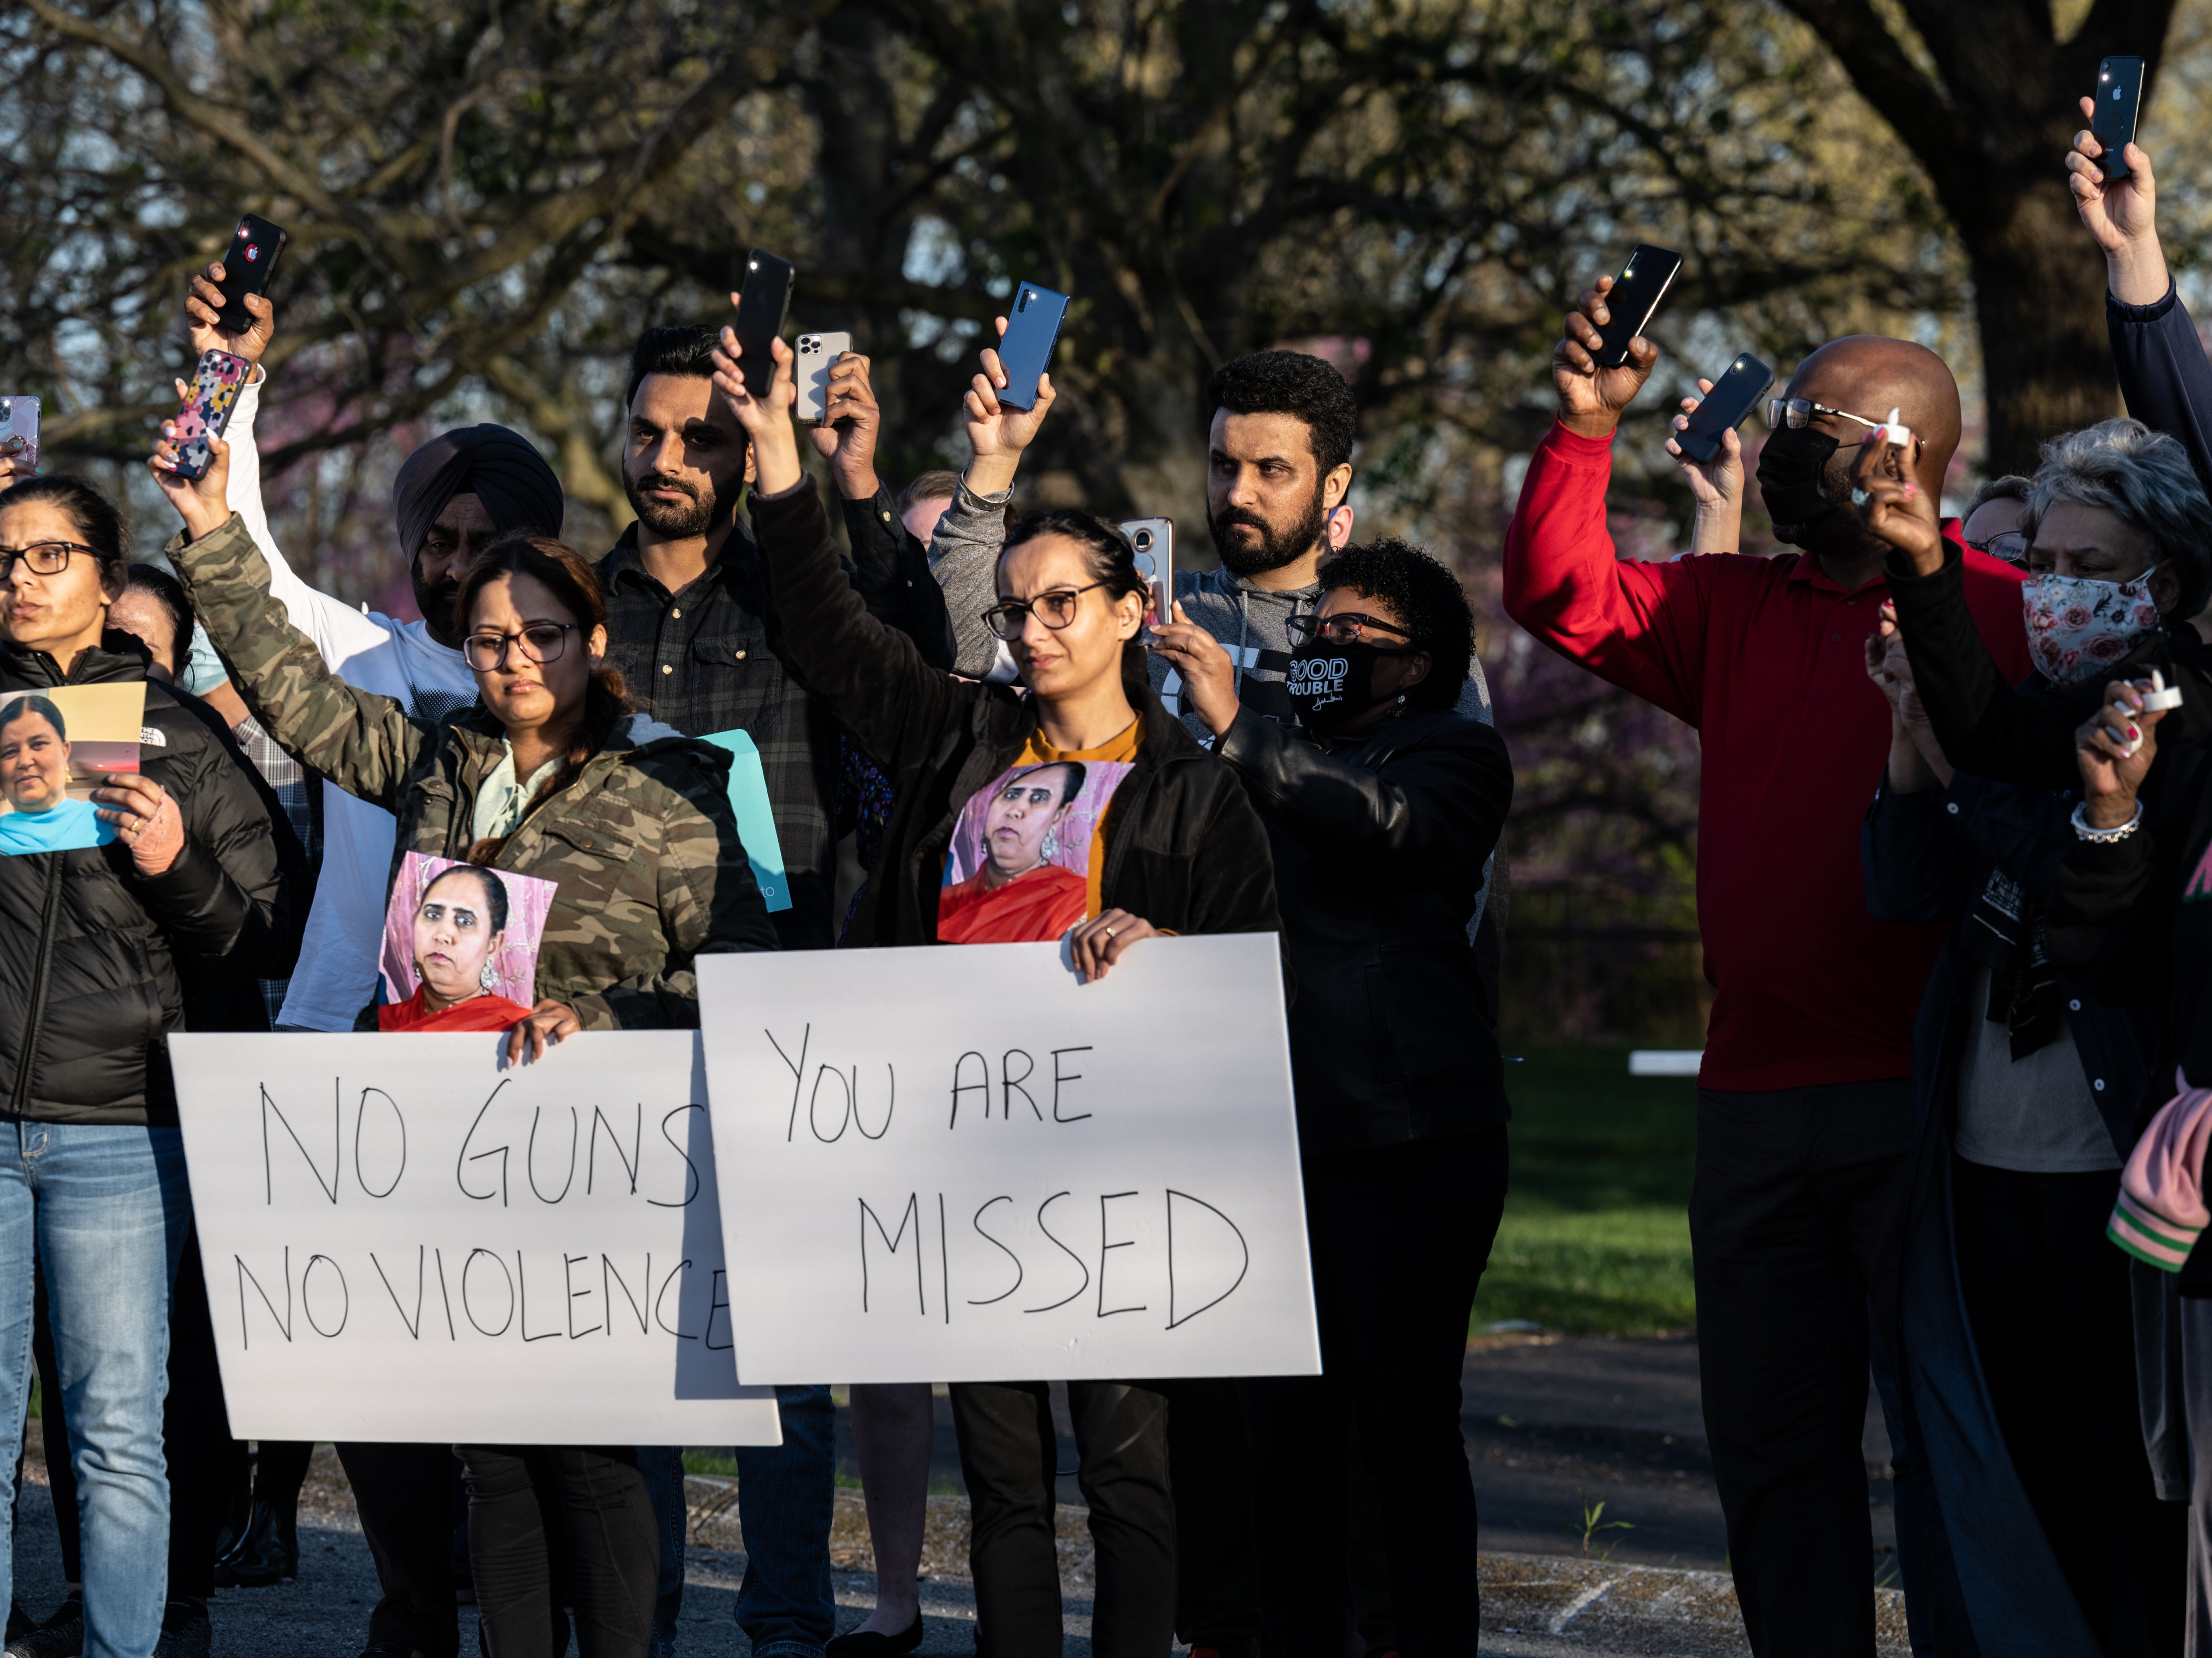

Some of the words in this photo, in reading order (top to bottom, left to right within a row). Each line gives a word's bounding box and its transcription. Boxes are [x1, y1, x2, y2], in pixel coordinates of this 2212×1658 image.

[1286, 679, 1343, 695] TROUBLE
[1290, 658, 1348, 682] GOOD
[765, 1023, 894, 1143] YOU
[949, 1045, 1093, 1130] ARE
[260, 1076, 406, 1205] NO
[457, 1078, 705, 1208] GUNS
[235, 1246, 349, 1350] NO
[370, 1245, 734, 1350] VIOLENCE
[858, 1188, 1249, 1330] MISSED
